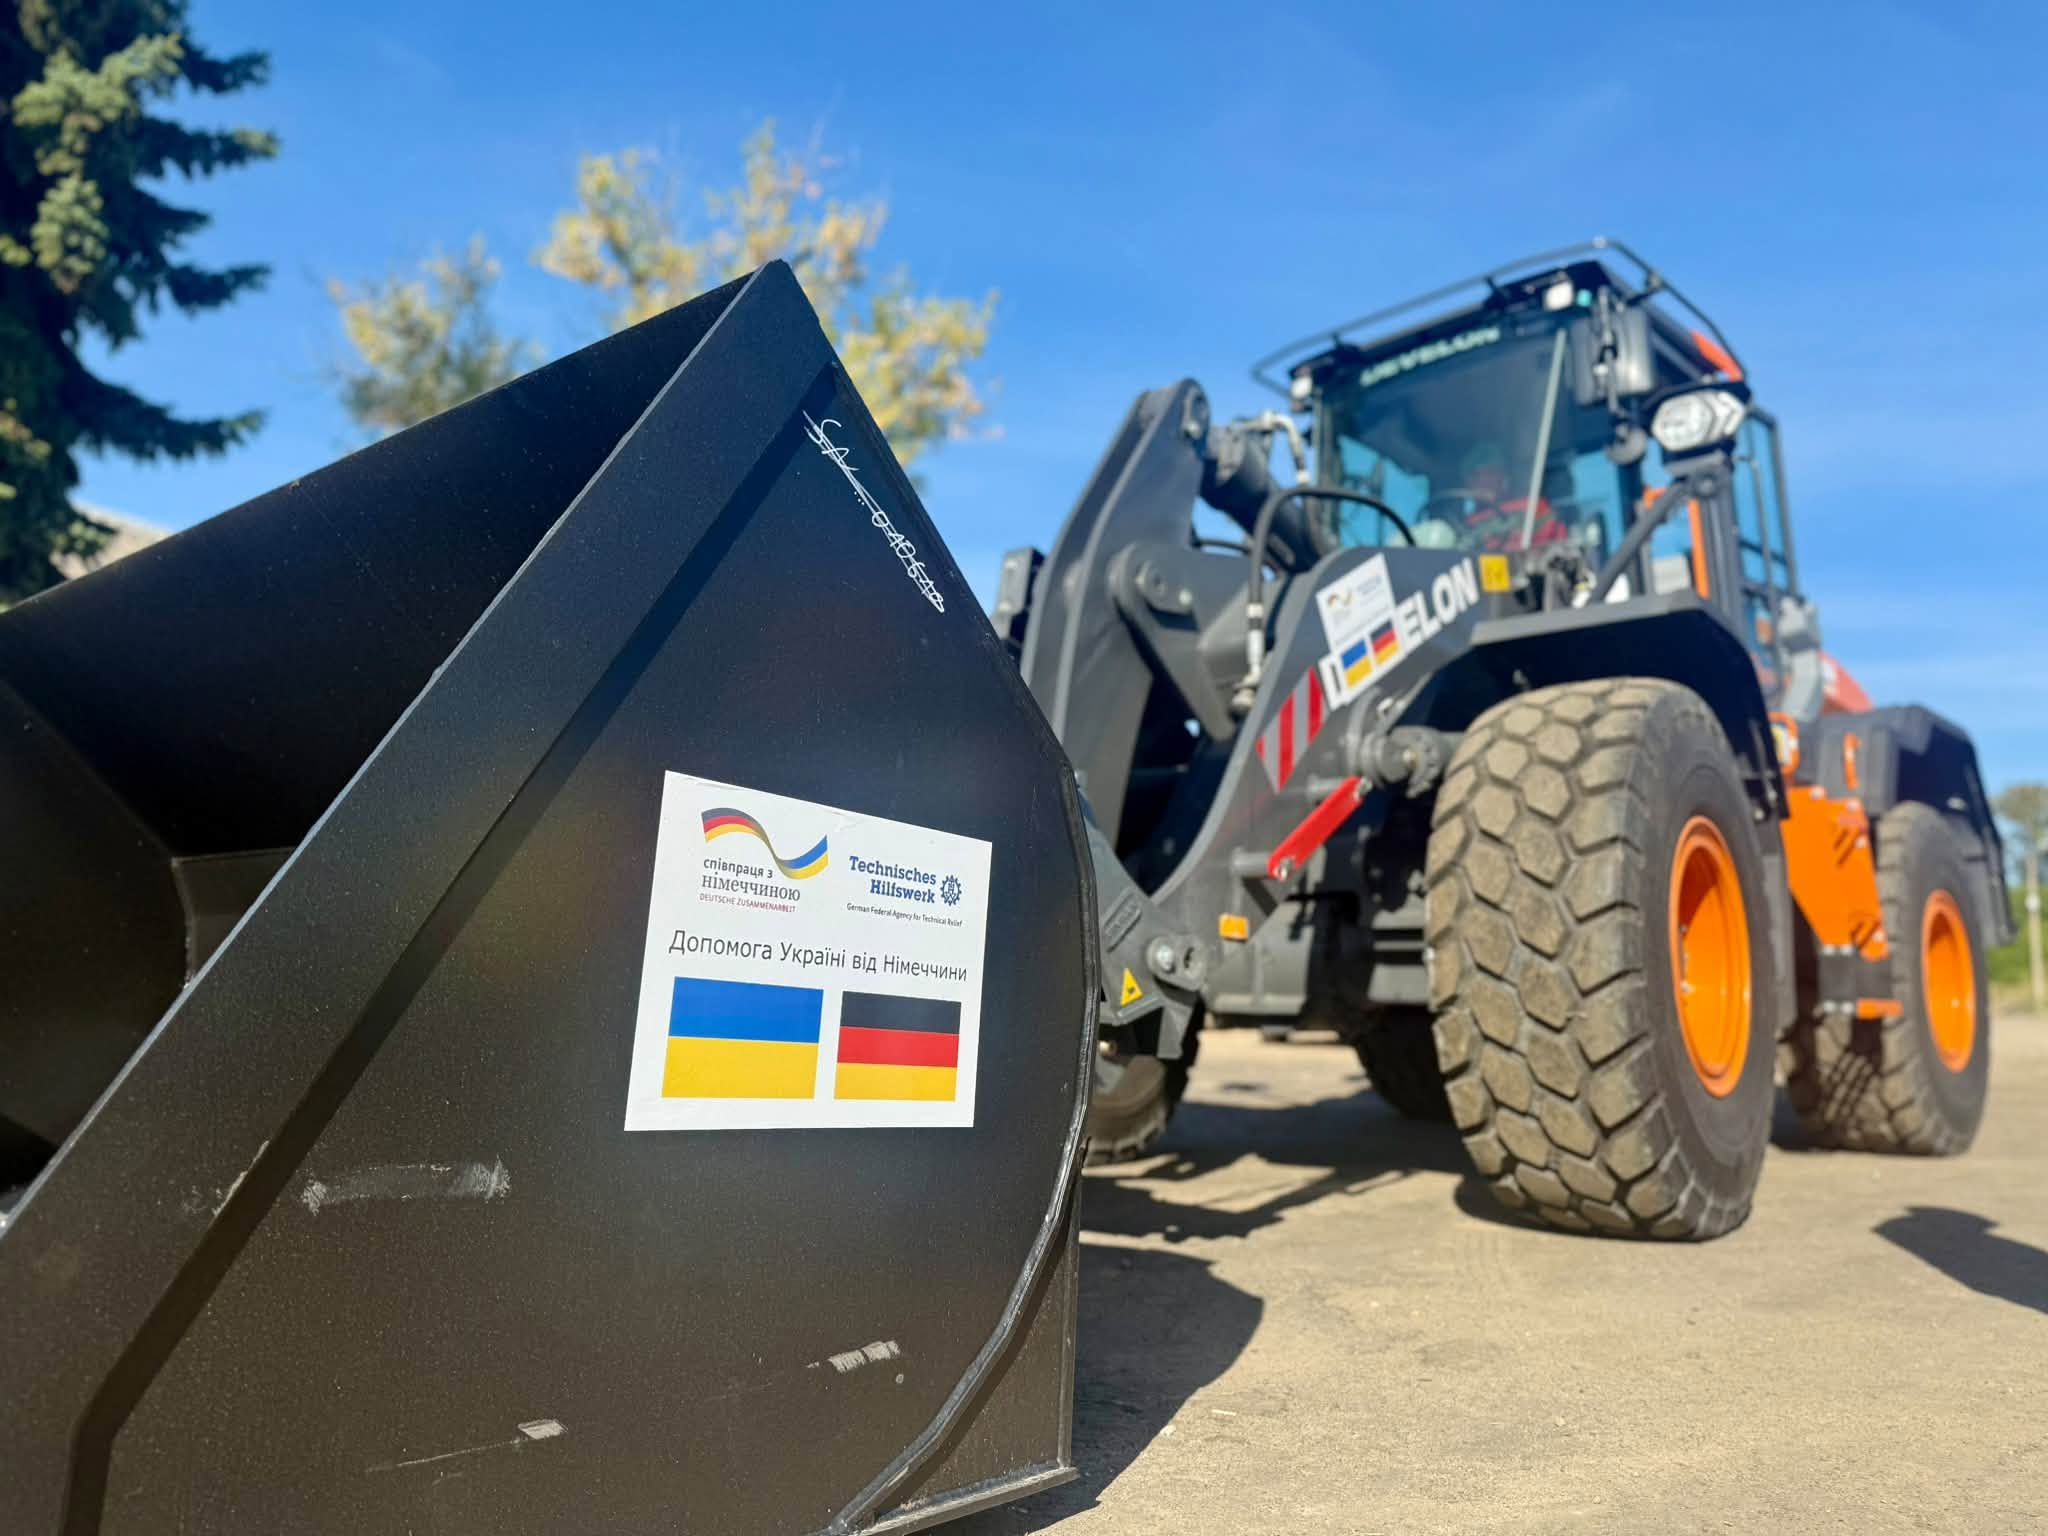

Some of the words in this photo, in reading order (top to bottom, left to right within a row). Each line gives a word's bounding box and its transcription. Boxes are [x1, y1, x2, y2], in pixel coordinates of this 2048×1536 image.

[1318, 557, 1480, 711] DELON
[703, 858, 764, 878] співпраця
[767, 869, 774, 879] з
[849, 855, 937, 885] Technisches
[702, 871, 801, 901] німеччиною
[870, 879, 935, 904] Hilfswerk
[699, 893, 736, 905] DEUTSCHE
[736, 898, 796, 913] ZUSAMMENARBEIT
[846, 903, 870, 913] German
[870, 906, 891, 917] Federal
[892, 909, 913, 921] Agency
[922, 914, 946, 925] Technical
[668, 929, 772, 961] Допомога
[779, 941, 846, 969] Україні
[852, 951, 877, 975] від
[883, 953, 967, 982] Німеччини
